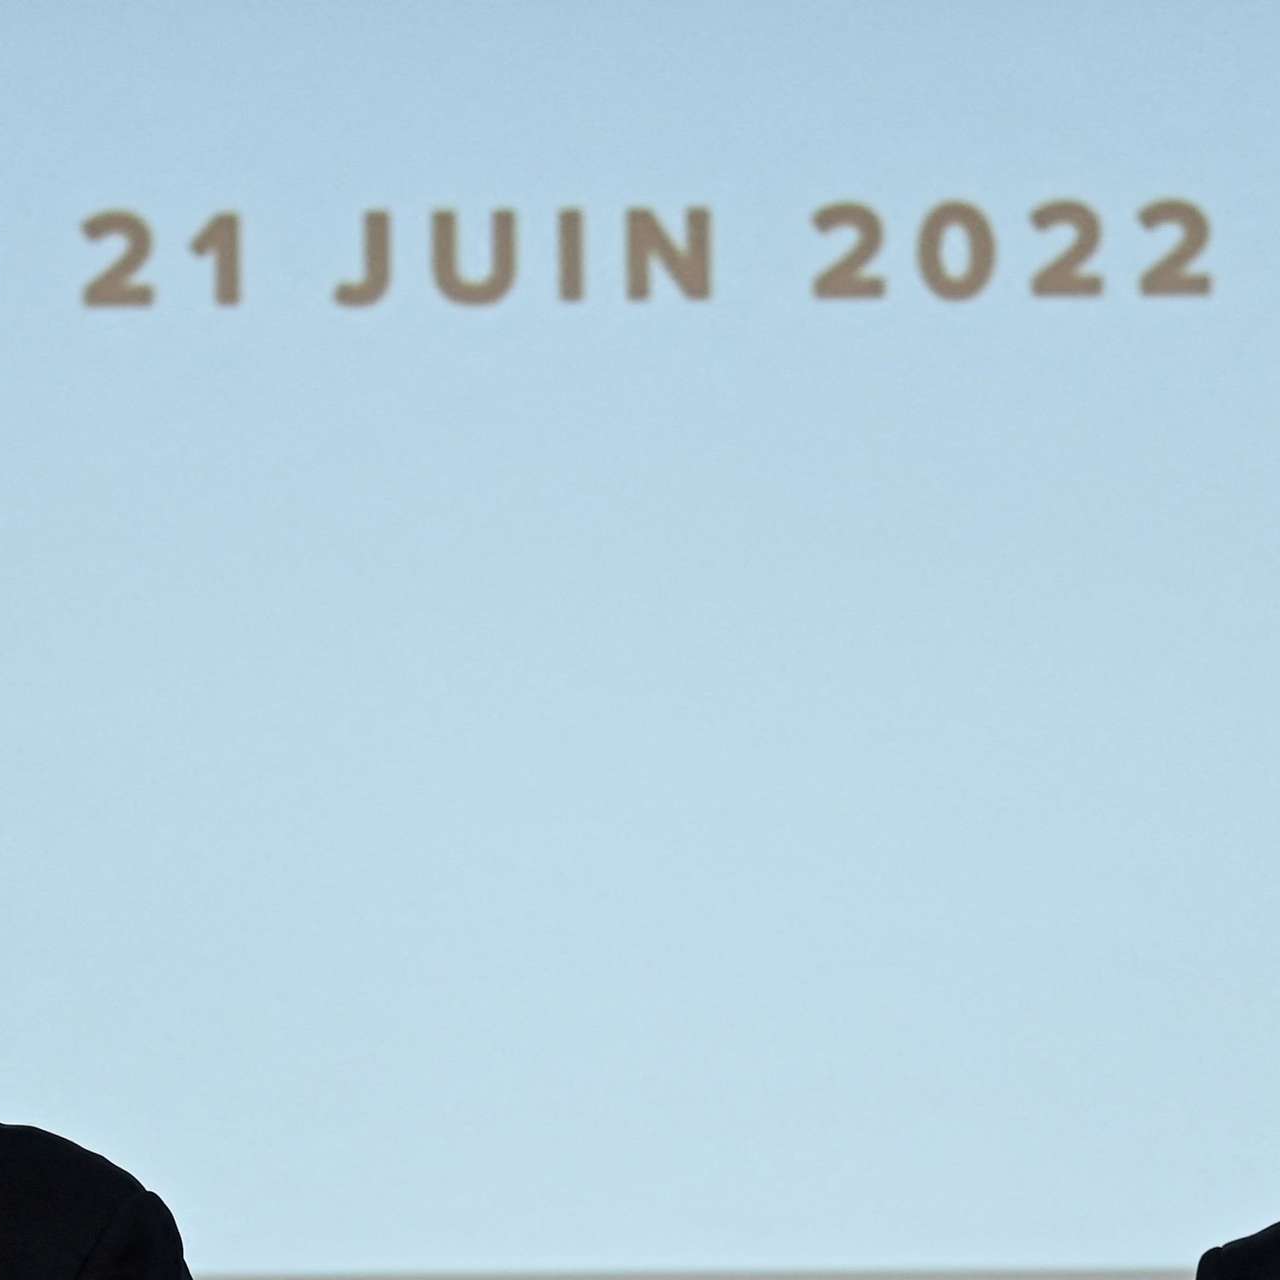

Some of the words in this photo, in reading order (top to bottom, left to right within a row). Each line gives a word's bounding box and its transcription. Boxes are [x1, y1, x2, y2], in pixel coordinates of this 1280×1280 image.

[79, 207, 246, 310] 21
[333, 203, 716, 310] JUIN
[809, 195, 1218, 303] 2022
